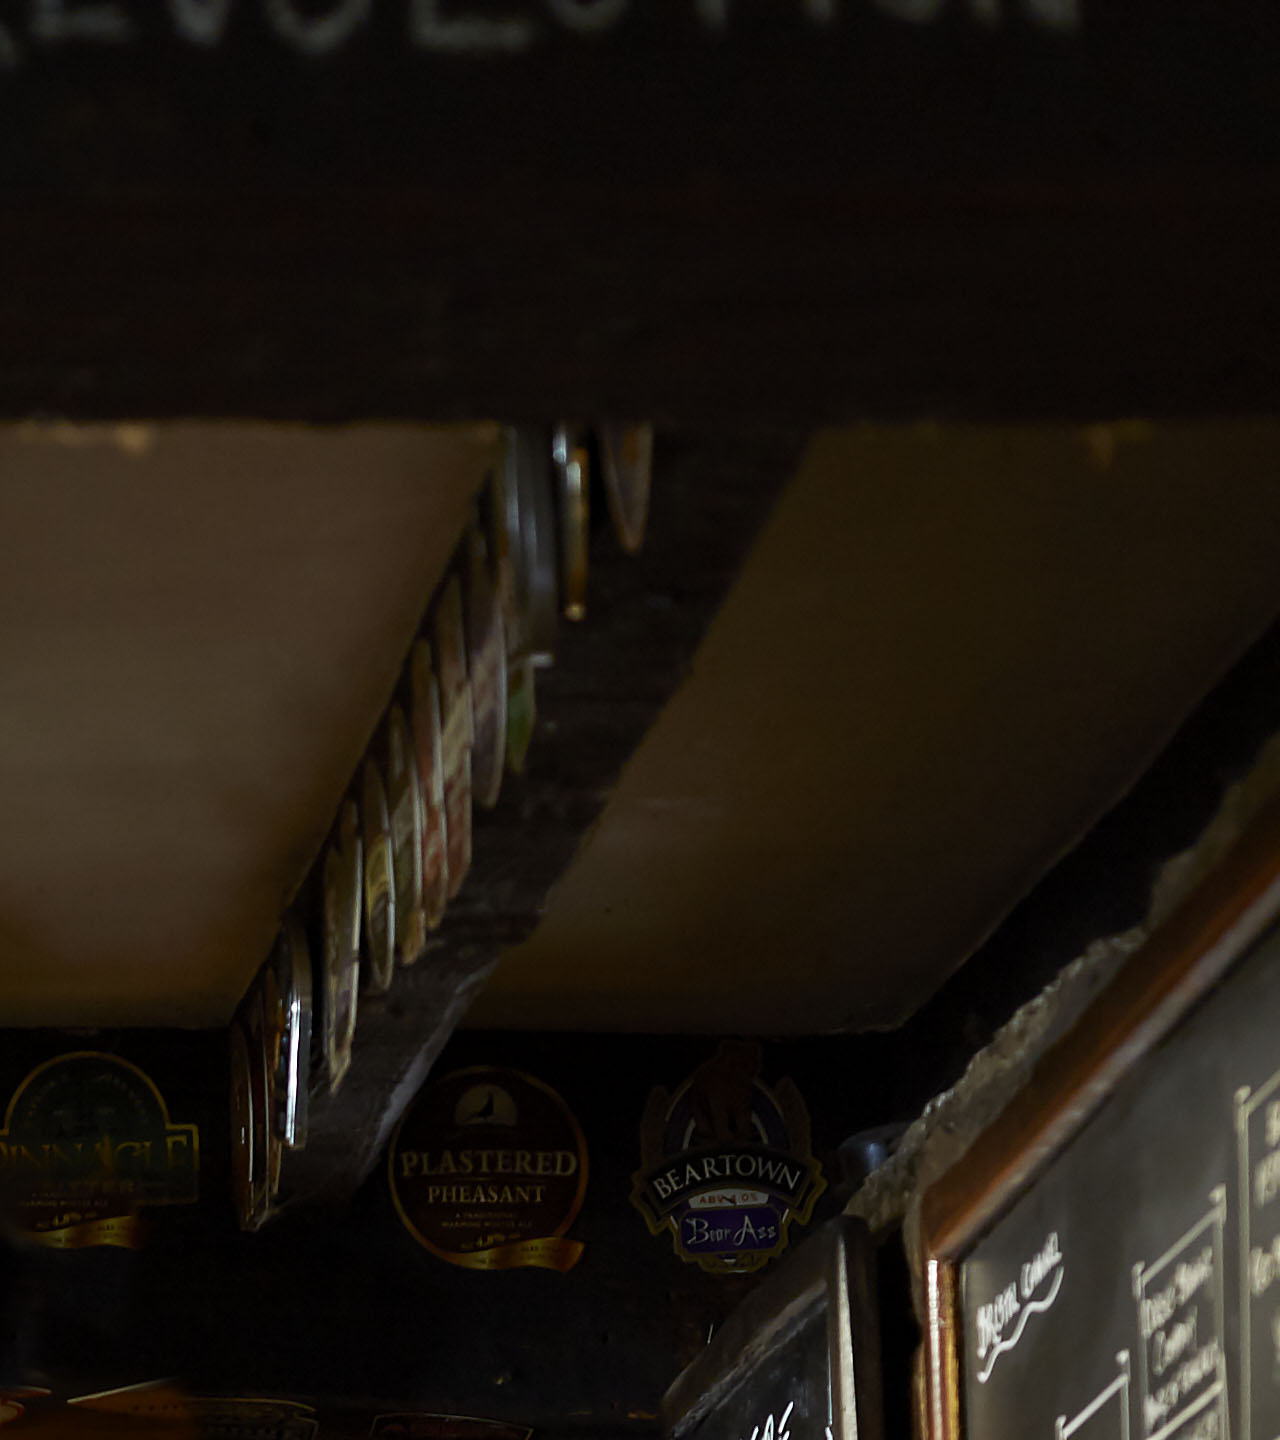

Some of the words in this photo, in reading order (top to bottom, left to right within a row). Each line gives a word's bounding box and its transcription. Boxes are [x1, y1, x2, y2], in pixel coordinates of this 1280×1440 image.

[398, 1149, 579, 1179] PLASTERED
[651, 1151, 803, 1200] BEARTOWN
[427, 1183, 548, 1206] PHEASANT
